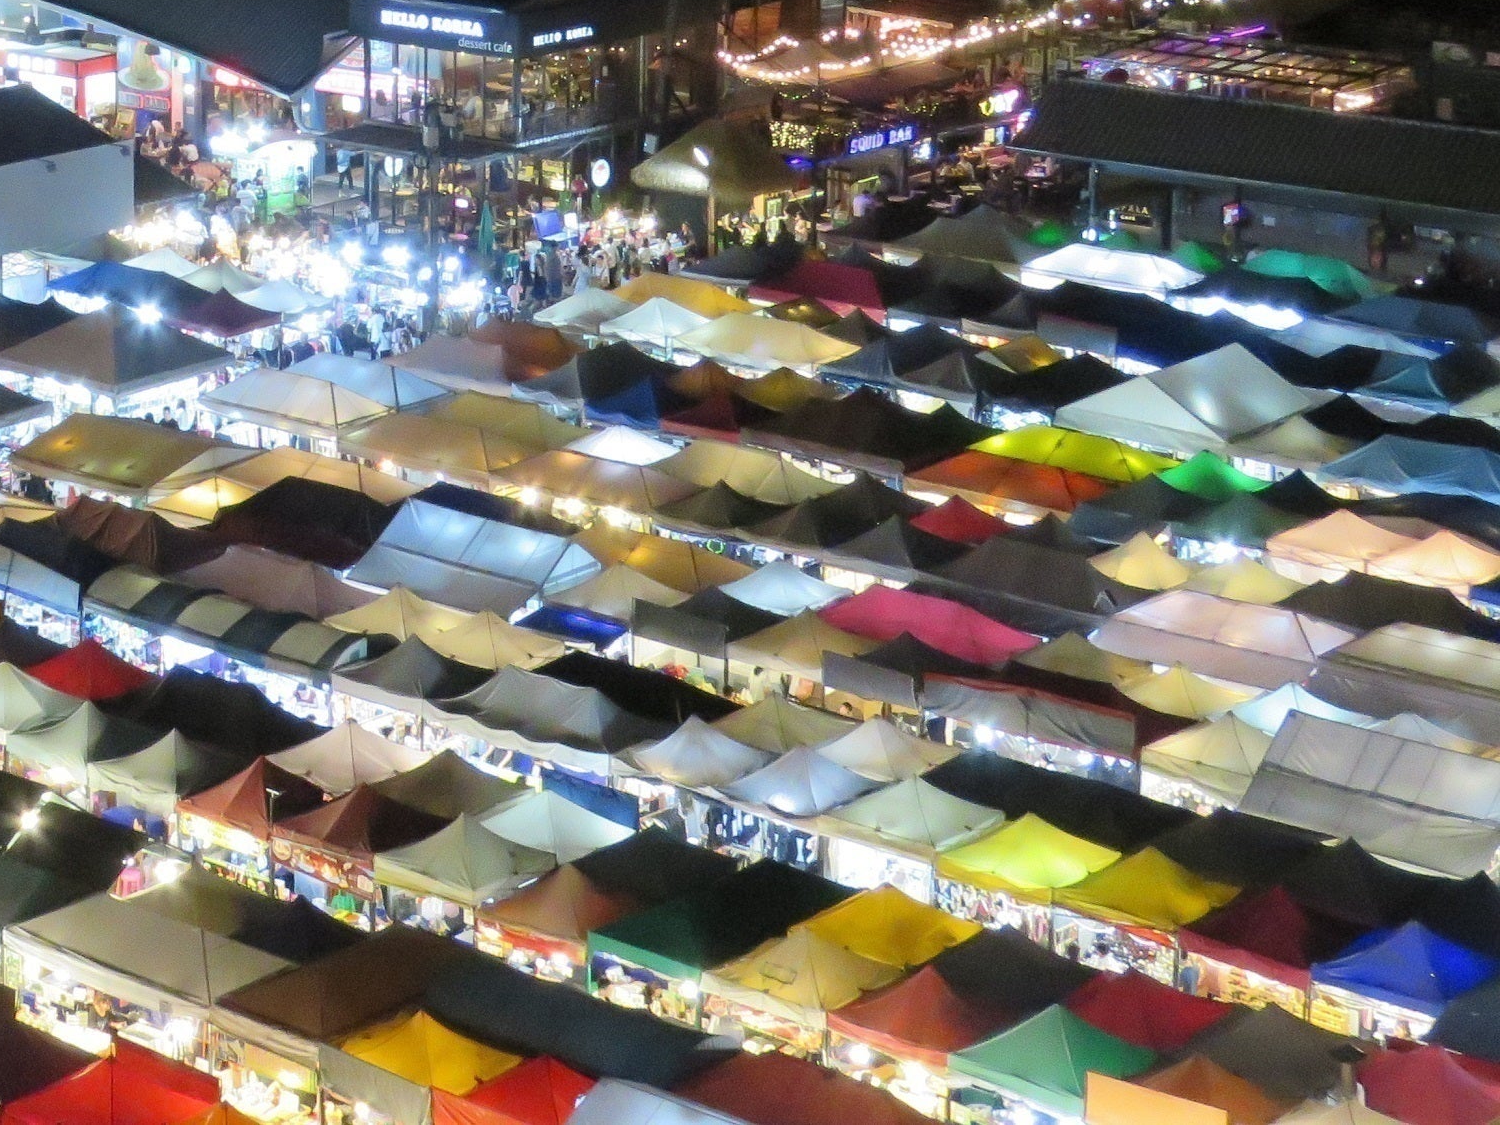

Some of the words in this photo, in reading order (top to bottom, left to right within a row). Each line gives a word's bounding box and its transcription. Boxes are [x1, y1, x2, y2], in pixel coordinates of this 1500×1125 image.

[380, 9, 429, 30] HELLO
[431, 16, 484, 37] KOREA
[458, 37, 491, 51] dessert
[533, 31, 562, 46] HELLO
[850, 132, 884, 154] SQUID
[889, 125, 913, 145] BAR
